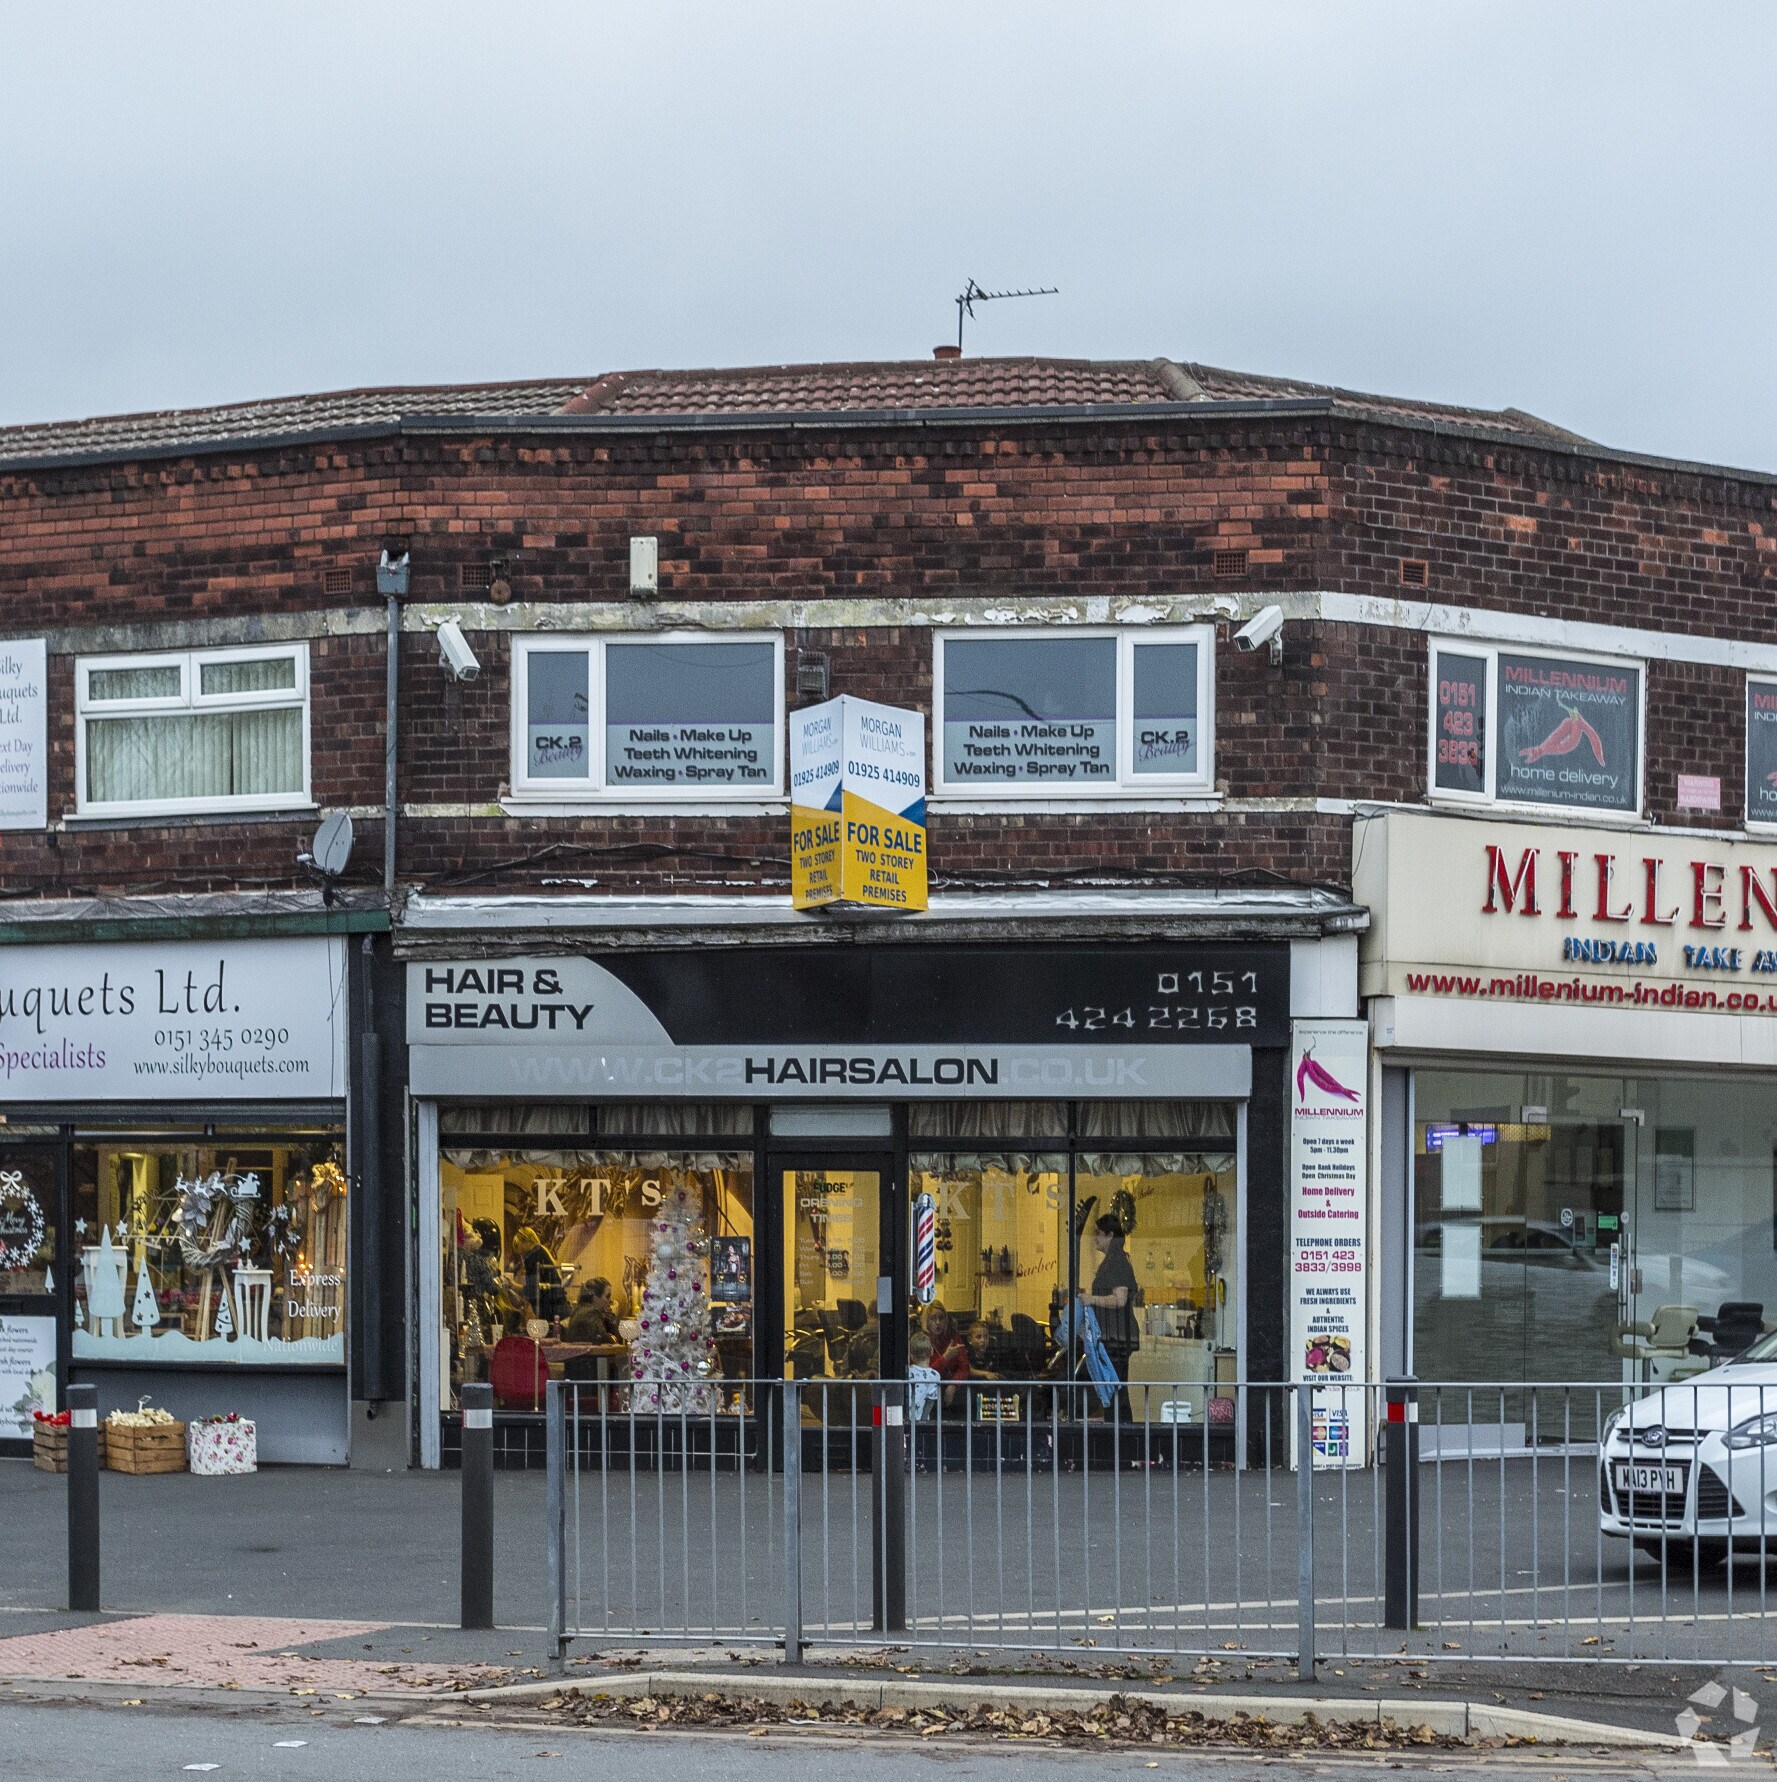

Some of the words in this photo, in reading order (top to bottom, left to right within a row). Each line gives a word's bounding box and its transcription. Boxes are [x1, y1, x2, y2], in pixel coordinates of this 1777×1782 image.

[0, 655, 23, 680] ilky
[1505, 665, 1628, 694] MILLENNIUM
[1440, 680, 1476, 708] 0151
[1504, 684, 1551, 699] INDIAN
[1554, 689, 1626, 706] TAKEAWAY
[803, 716, 832, 739] MORGAN
[861, 716, 902, 739] MORGAN
[969, 725, 1010, 738] Nails
[1020, 725, 1065, 738] Make
[1070, 725, 1094, 740] Up
[1444, 710, 1473, 736] 423
[629, 729, 670, 742] Nails
[680, 729, 726, 742] Make
[728, 729, 752, 744] Up
[14, 739, 33, 757] Day
[623, 748, 670, 760] Teeth
[674, 748, 757, 762] Whitening
[963, 744, 1011, 756] Teeth
[1014, 744, 1100, 758] Whitening
[1439, 739, 1478, 766] 3833
[614, 766, 676, 780] Waxing
[685, 766, 734, 780] Spray
[737, 765, 767, 778] Tan
[794, 769, 814, 787] 01925
[815, 759, 840, 780] 414909
[848, 761, 880, 780] 01925
[883, 768, 920, 788] 414909
[954, 761, 1016, 776] Waxing
[1026, 761, 1077, 777] Spray
[1080, 761, 1110, 774] Tan
[1510, 763, 1555, 780] home
[1559, 768, 1618, 789] delivery
[794, 828, 814, 853] FOR
[815, 821, 839, 847] SALE
[847, 821, 880, 847] FOR
[884, 827, 922, 854] SALE
[800, 855, 812, 868] TWO
[814, 849, 835, 866] STOREY
[855, 849, 876, 865] TWO
[880, 853, 914, 870] STOREY
[809, 869, 828, 884] RETAIL
[870, 868, 900, 885] RETAIL
[806, 884, 833, 901] PREMISES
[862, 884, 907, 903] PREMISES
[1564, 936, 1658, 965] INDIAN
[1683, 944, 1743, 971] TAKE
[155, 960, 241, 1014] Ltd.
[426, 968, 524, 994] HAIR
[533, 969, 563, 994] &
[1157, 970, 1257, 996] 0151
[426, 1003, 595, 1030] BEAUTY
[1055, 1006, 1136, 1030] 424
[154, 1028, 193, 1051] 0151
[199, 1028, 233, 1051] 345
[240, 1027, 290, 1050] 0290
[133, 1053, 310, 1080] www.silkybouquets.com
[1294, 1108, 1364, 1116] MILLENNIUM
[1302, 1137, 1317, 1145] Open
[1322, 1138, 1335, 1146] days
[1310, 1146, 1323, 1154] 5pm
[1302, 1163, 1316, 1171] Open
[1332, 1164, 1355, 1172] Holidays
[1302, 1172, 1316, 1180] Open
[1317, 1172, 1345, 1180] Christmas
[1302, 1186, 1323, 1196] Home
[1324, 1187, 1355, 1197] Delivery
[800, 1198, 863, 1208] OPENING
[1326, 1199, 1331, 1207] &
[1298, 1209, 1326, 1219] Outside
[1327, 1209, 1359, 1220] Catering
[1295, 1238, 1332, 1247] TELEPHONE
[1334, 1238, 1361, 1247] ORDERS
[1300, 1250, 1328, 1260] 0151
[1332, 1250, 1355, 1260] 423
[1294, 1260, 1362, 1274] 3833/3998
[290, 1269, 341, 1292] Express
[1300, 1297, 1318, 1305] FRESH
[1319, 1297, 1356, 1305] INGREDIENTS
[288, 1298, 342, 1324] Delivery
[1307, 1325, 1328, 1333] INDIAN
[1328, 1325, 1349, 1333] SPICES
[262, 1333, 338, 1352] Nationwide
